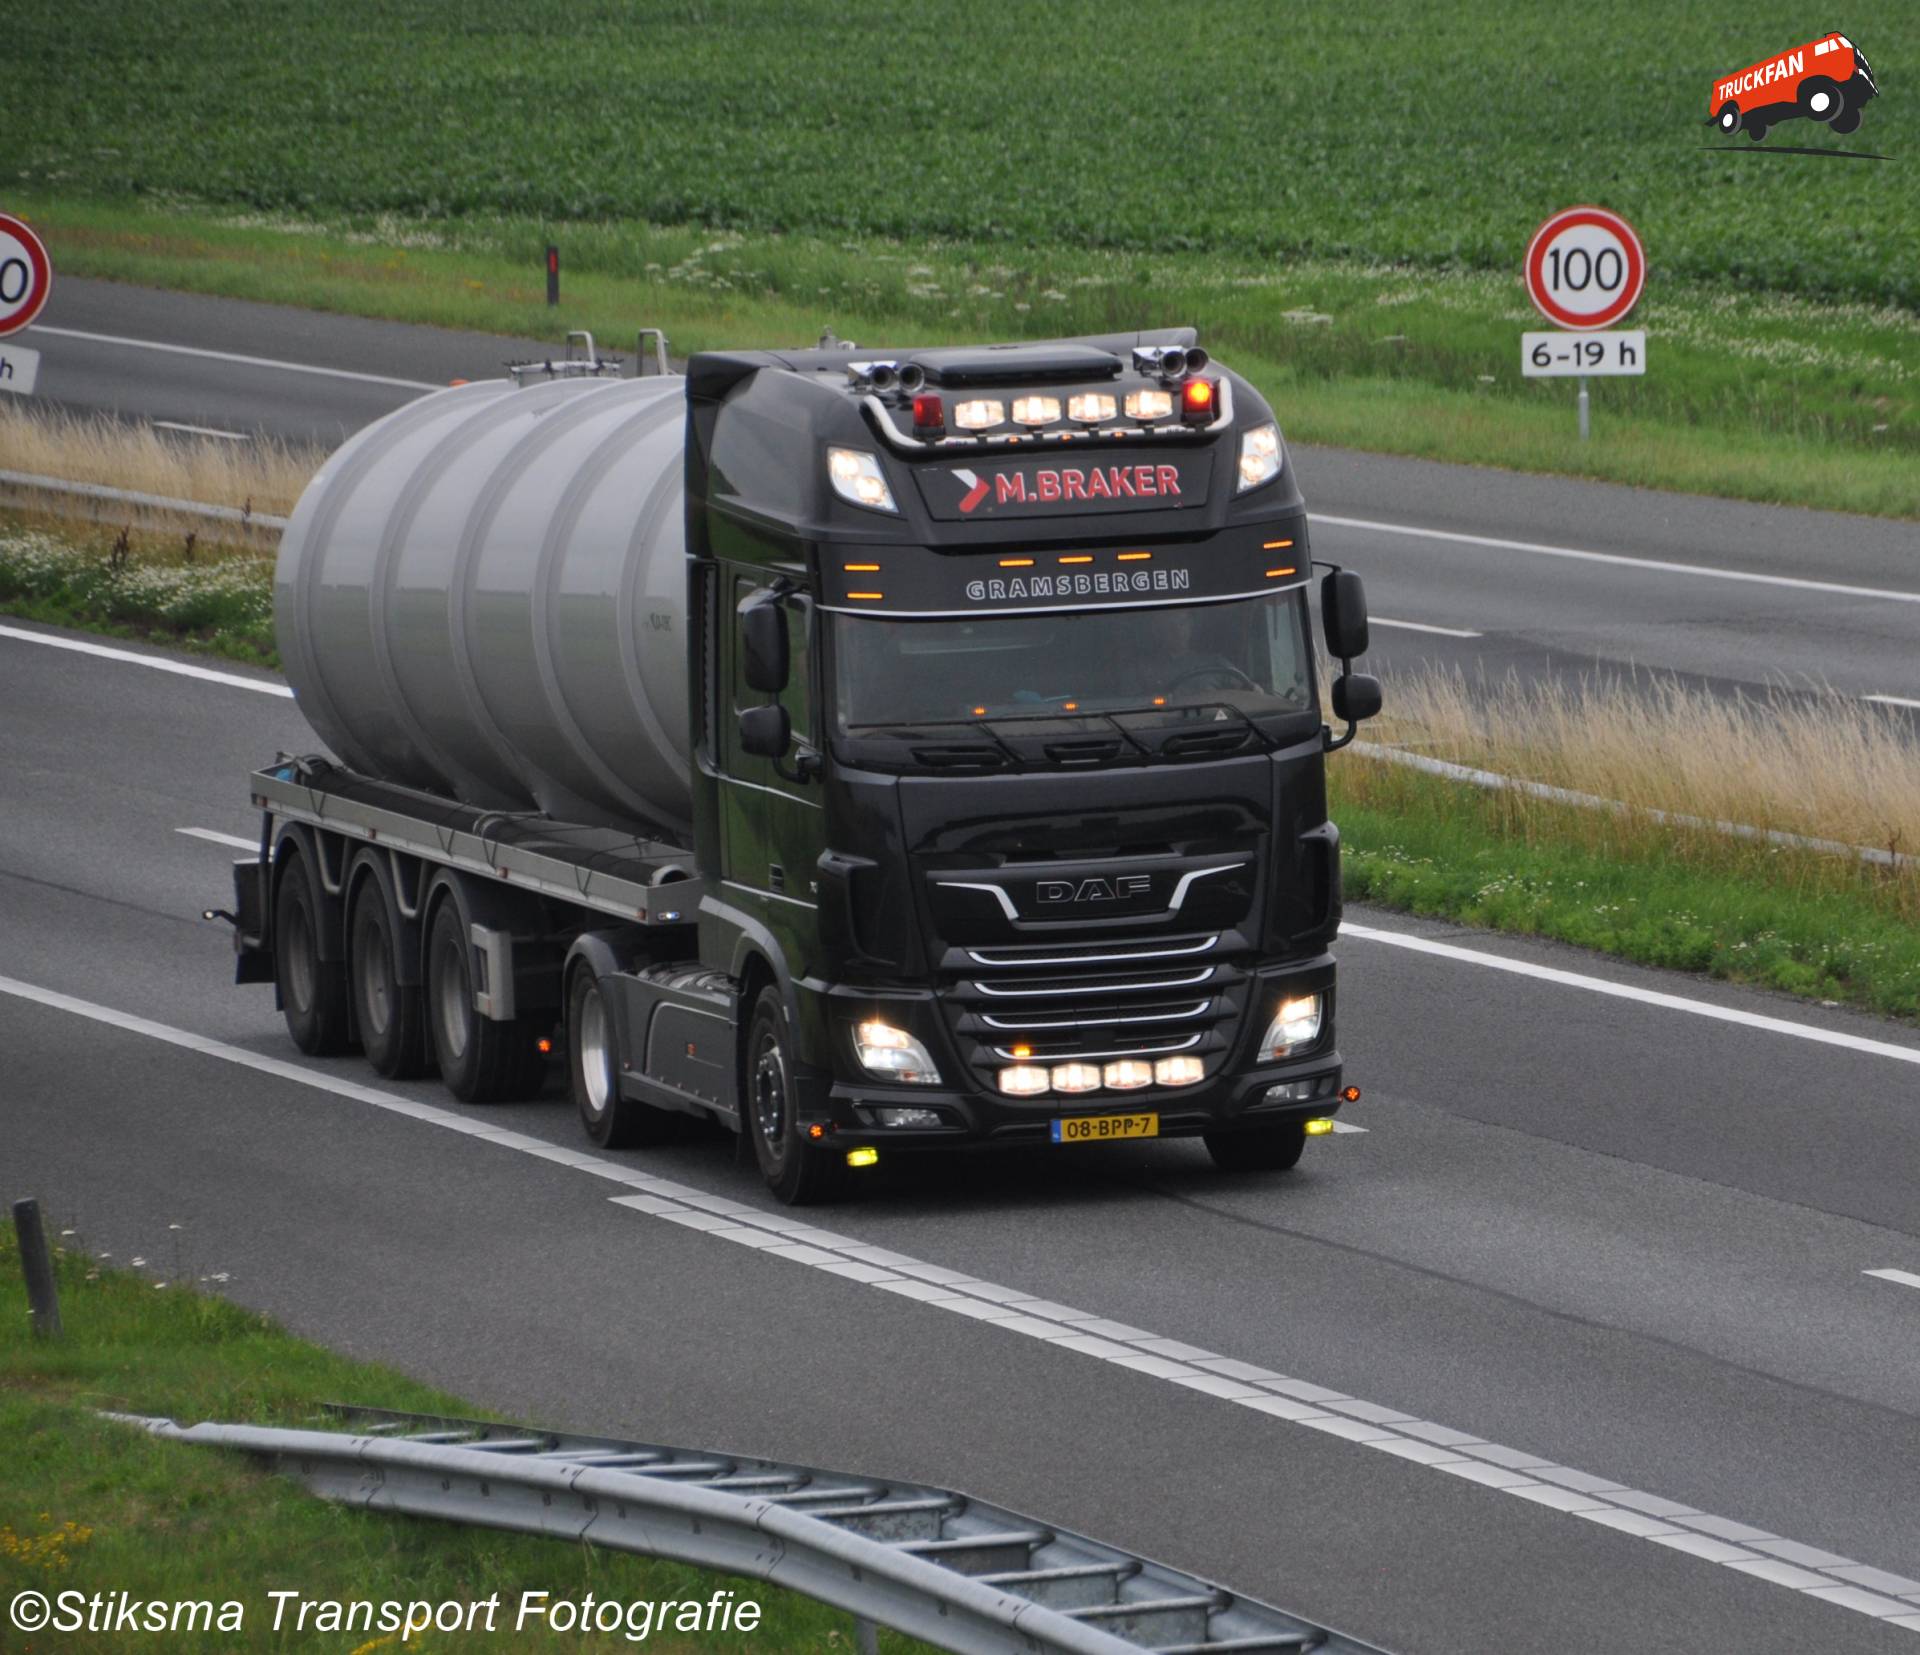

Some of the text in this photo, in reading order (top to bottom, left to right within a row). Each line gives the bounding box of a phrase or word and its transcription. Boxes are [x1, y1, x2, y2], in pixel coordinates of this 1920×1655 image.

[1549, 247, 1622, 291] 100
[1531, 340, 1636, 367] 6-19 h
[994, 464, 1182, 504] M.BRAKER
[966, 569, 1190, 600] GRAMSBERGEN
[1036, 874, 1151, 904] DAF
[1066, 1117, 1151, 1139] 08-BPP-7
